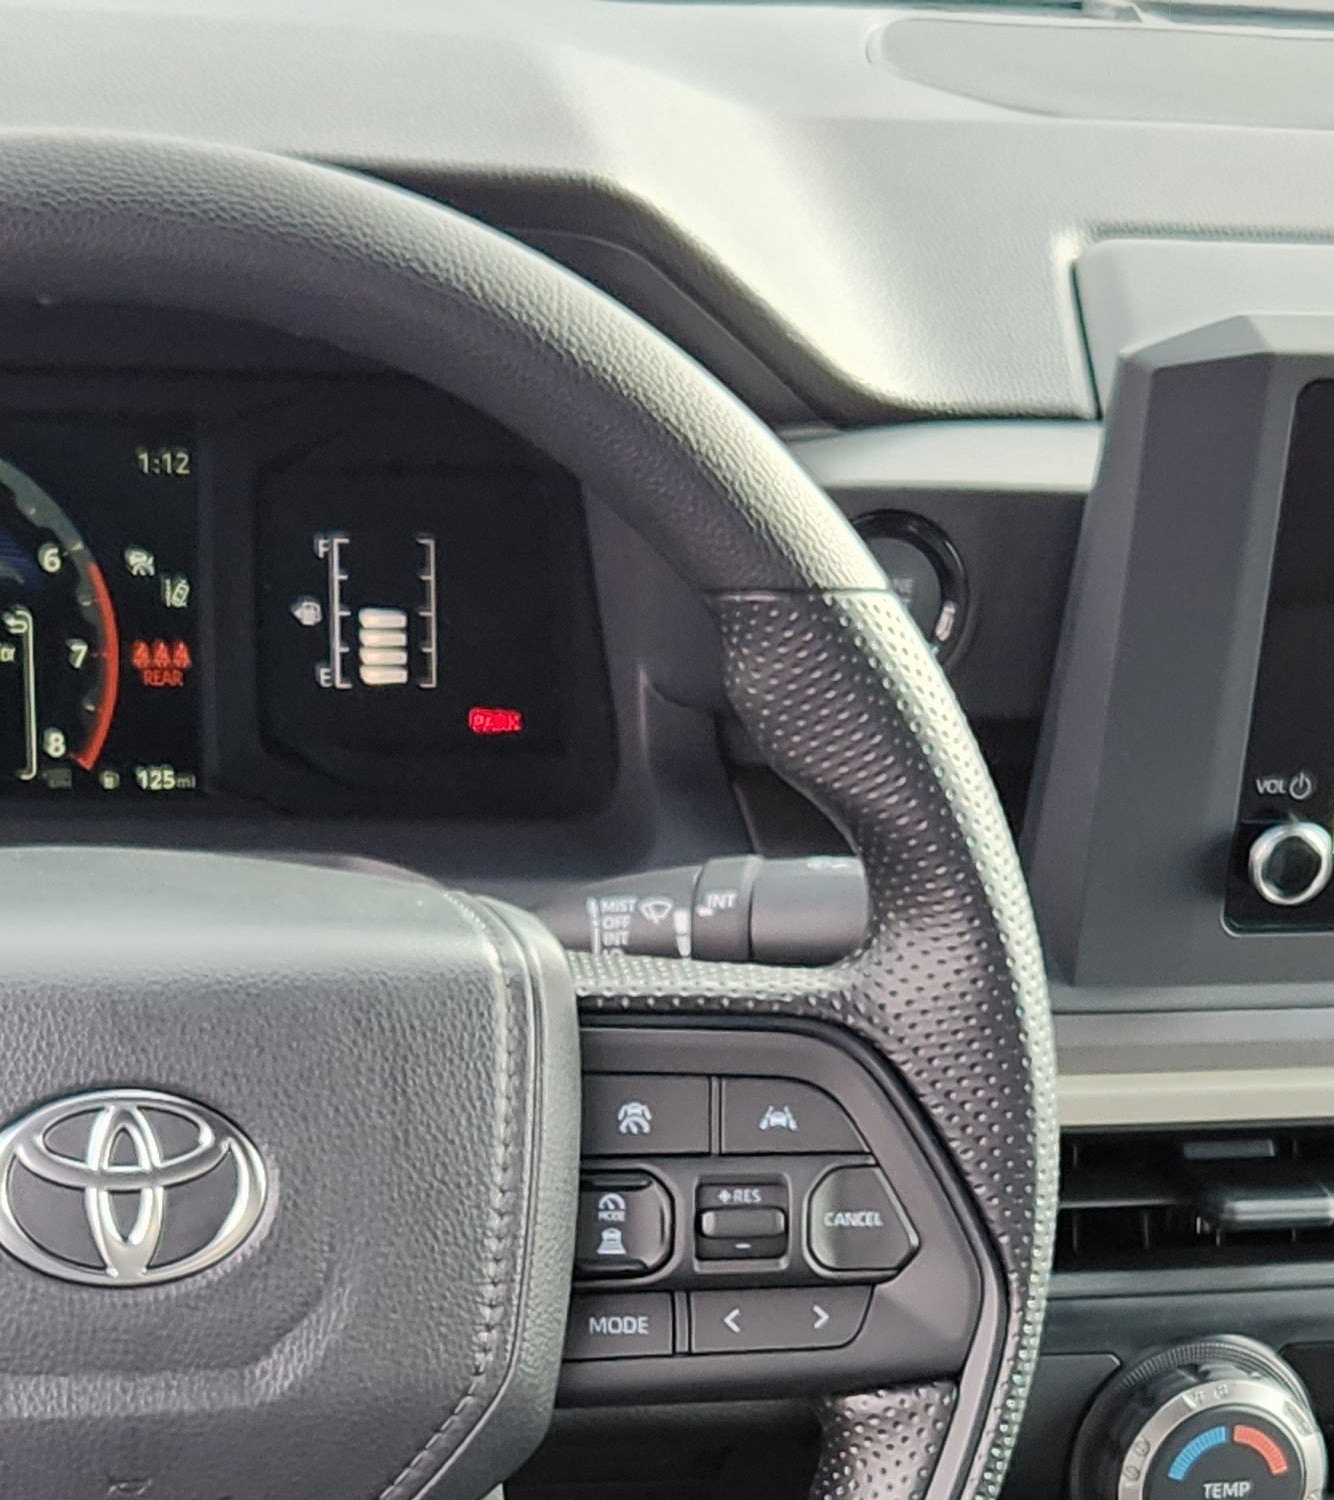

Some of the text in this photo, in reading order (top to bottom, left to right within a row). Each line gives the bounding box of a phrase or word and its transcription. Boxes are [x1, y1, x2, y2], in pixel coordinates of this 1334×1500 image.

[136, 449, 190, 474] 1:12
[40, 545, 62, 573] 6
[69, 641, 88, 669] 7
[318, 667, 332, 688] E
[45, 730, 66, 758] 8
[1255, 778, 1285, 795] VOL
[708, 892, 737, 909] INT
[823, 1211, 883, 1229] CANCEL
[588, 1315, 650, 1336] MODE
[1202, 1480, 1252, 1500] TEMP
